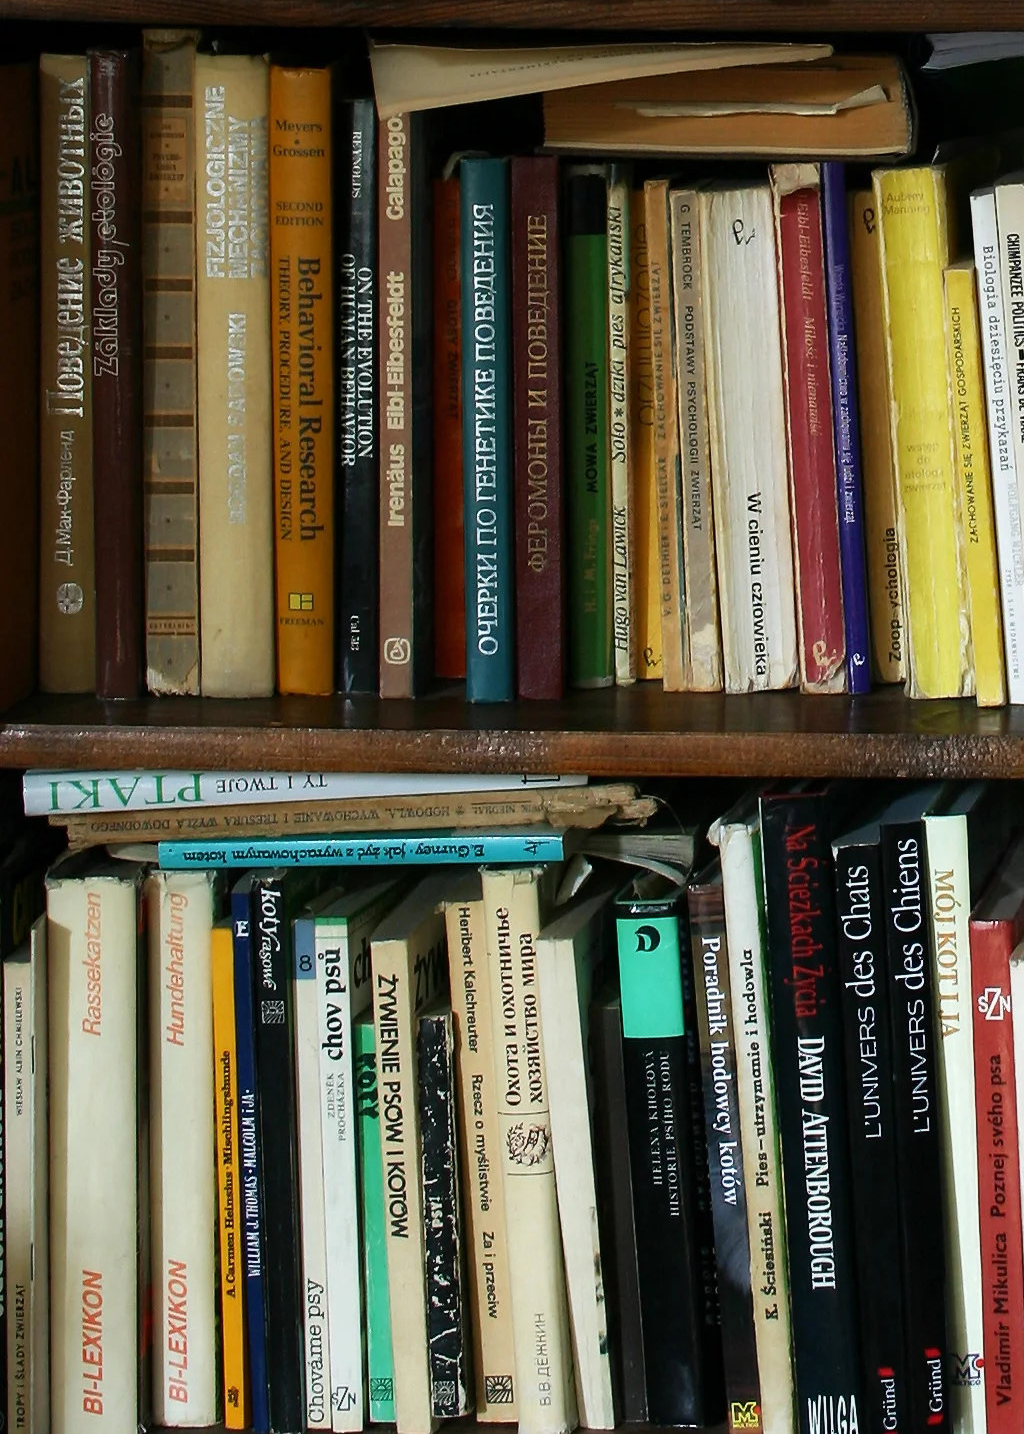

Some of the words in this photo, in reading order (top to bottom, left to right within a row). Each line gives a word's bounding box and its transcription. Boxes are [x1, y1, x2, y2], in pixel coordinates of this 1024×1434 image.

[53, 78, 85, 243] животных
[471, 204, 495, 361] ПОВЕДЕНИЯ
[525, 215, 549, 378] ПОВЕДЕНИЕ
[46, 258, 88, 418] Поведение
[384, 271, 406, 430] Eibl-Eibesfeldt
[474, 368, 496, 502] ГЕНЕТИКЕ
[527, 388, 547, 407] И
[581, 361, 599, 435] ZWIERZĄT
[384, 445, 406, 527] Irenäus
[527, 419, 549, 573] ФЕРОМОНЫ
[584, 443, 598, 493] MOWA
[477, 510, 497, 545] ПО
[476, 553, 498, 655] ОЧЕРКИ
[48, 772, 204, 809] PTAKI
[216, 777, 277, 794] TWOJE
[286, 775, 291, 790] I
[303, 773, 327, 788] TY
[839, 865, 874, 940] Chats
[892, 838, 924, 933] Chiens
[82, 893, 101, 1036] Rassekatzen
[167, 893, 188, 1046] Hundehaltung
[318, 948, 346, 992] psů
[493, 908, 515, 1019] охотничье
[517, 933, 539, 986] мира
[849, 950, 877, 997] des
[899, 942, 924, 990] des
[322, 1002, 344, 1060] chov
[501, 1023, 516, 1037] и
[520, 992, 544, 1103] хозяйство
[906, 999, 931, 1132] L'UNIVERS
[502, 1042, 524, 1106] Охота
[796, 1036, 825, 1103] DAVID
[858, 1007, 882, 1138] L'UNIVERS
[801, 1109, 837, 1289] ATTENBOROUGH
[82, 1271, 102, 1414] BI-LEXIKON
[168, 1260, 188, 1402] BI-LEXIKON
[879, 1379, 897, 1431] Gründ
[925, 1359, 943, 1413] Gründ
